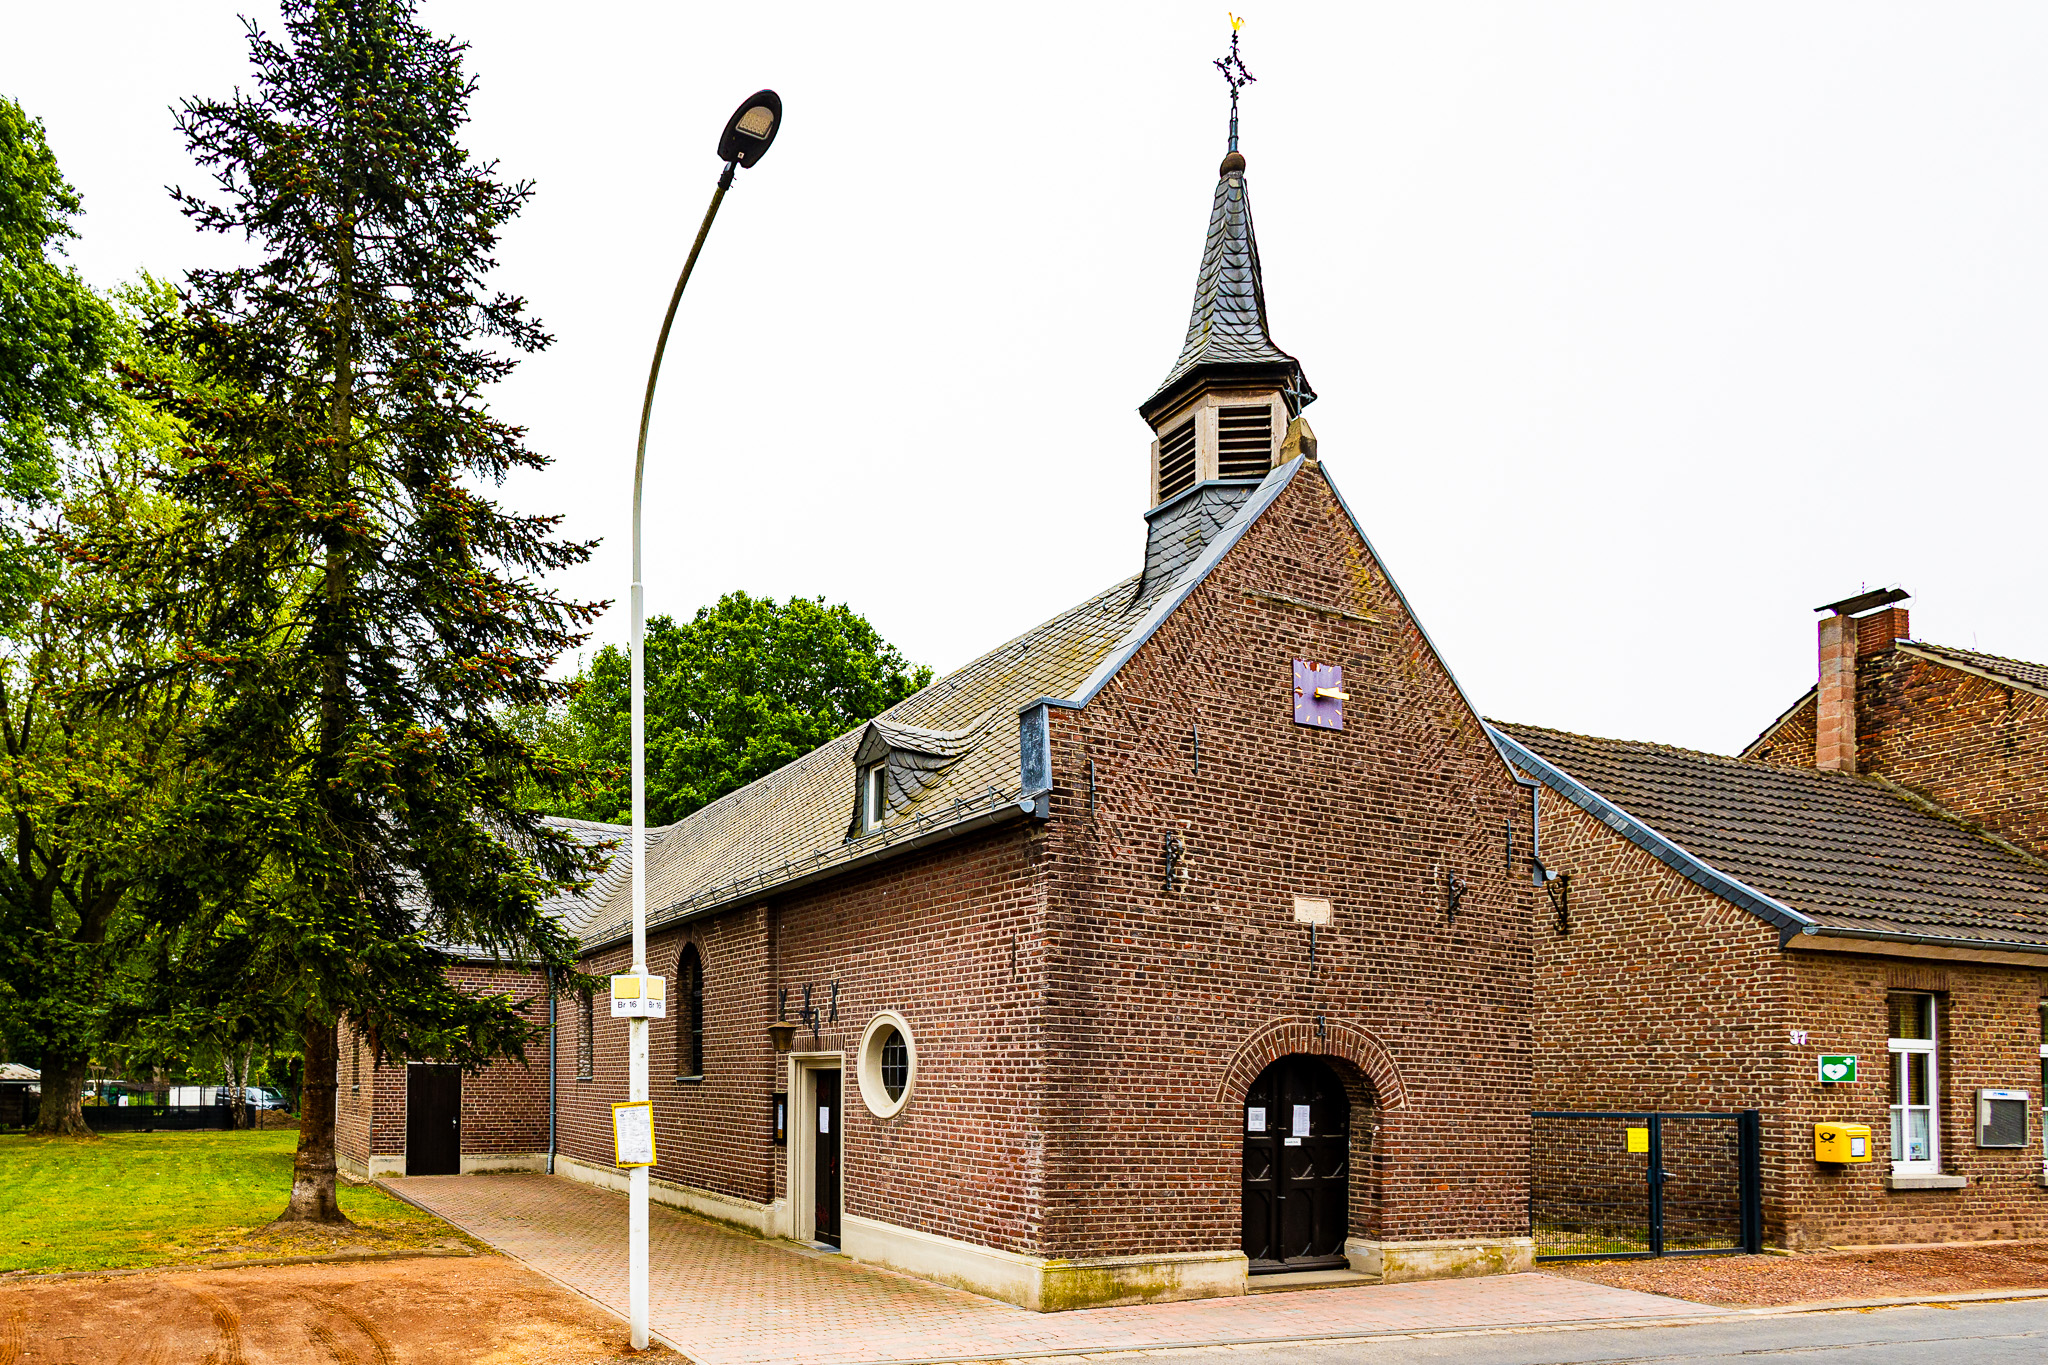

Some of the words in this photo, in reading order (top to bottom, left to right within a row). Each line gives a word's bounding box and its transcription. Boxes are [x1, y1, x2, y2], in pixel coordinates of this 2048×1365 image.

[617, 1001, 626, 1009] Br
[629, 1000, 637, 1008] 16
[648, 1001, 655, 1009] Br
[1789, 1030, 1807, 1046] 37
